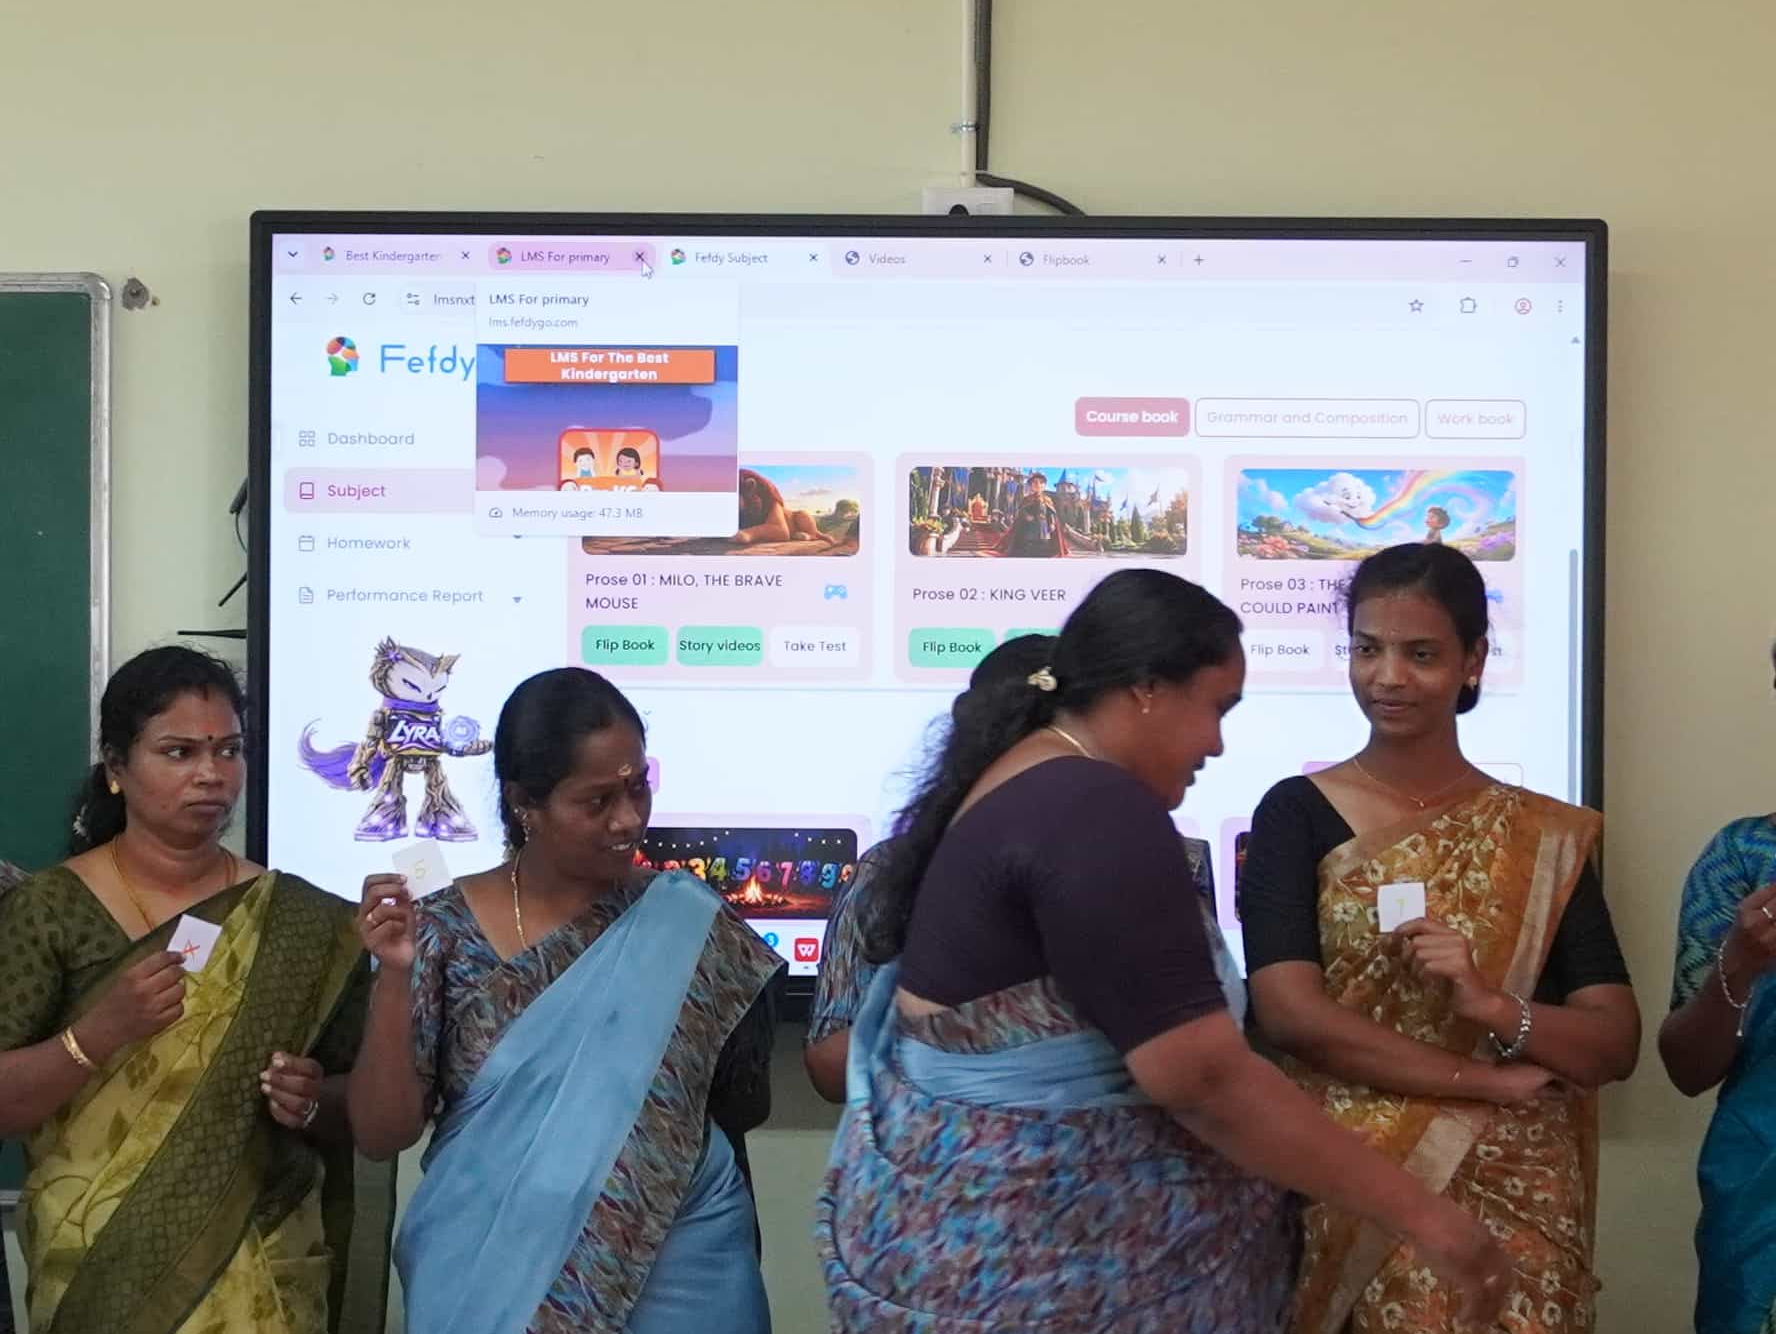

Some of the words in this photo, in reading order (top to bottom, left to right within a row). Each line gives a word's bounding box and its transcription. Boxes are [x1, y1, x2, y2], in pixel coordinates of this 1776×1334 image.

[345, 251, 370, 262] Best
[520, 251, 545, 262] LMS
[547, 252, 566, 263] For
[568, 252, 611, 266] primary
[694, 253, 724, 265] Fefdy
[727, 253, 768, 266] Subject
[868, 254, 906, 264] Videos
[489, 294, 515, 305] LMS
[518, 294, 539, 305] For
[542, 295, 590, 309] primary
[379, 344, 476, 381] Fefdy
[550, 351, 579, 364] LMS
[581, 351, 607, 364] For
[609, 351, 634, 365] The
[636, 351, 669, 365] Best
[560, 367, 658, 384] Kindergarten
[1085, 409, 1139, 425] Course
[1141, 409, 1179, 425] book
[1207, 411, 1279, 424] Grammar
[1282, 411, 1311, 424] and
[1313, 411, 1409, 428] Composition
[1437, 412, 1473, 425] Work
[1477, 412, 1514, 425] book
[327, 431, 415, 446] Dashboard
[327, 484, 386, 500] Subject
[512, 507, 558, 521] Memory
[625, 508, 644, 519] MB
[327, 536, 411, 550] Homework
[585, 573, 628, 586] Prose
[632, 573, 647, 586] 01
[659, 574, 699, 588] MILO,
[703, 574, 729, 587] THE
[734, 575, 783, 587] BRAVE
[1240, 578, 1282, 591] Prose
[1287, 578, 1306, 591] 03
[327, 588, 428, 603] Performance
[432, 589, 484, 606] Report
[912, 588, 955, 601] Prose
[959, 588, 978, 601] 02
[989, 588, 1026, 601] KING
[1030, 589, 1067, 602] VEER
[585, 597, 639, 610] MOUSE
[1240, 602, 1293, 615] COULD
[595, 639, 619, 654] Flip
[622, 639, 655, 651] Book
[679, 639, 714, 654] Story
[716, 639, 761, 652] videos
[783, 640, 815, 652] Take
[820, 641, 847, 652] Test
[923, 641, 946, 656] Flip
[950, 641, 982, 653] Book
[1250, 644, 1274, 657] Flip
[1277, 644, 1310, 656] Book
[387, 719, 441, 747] LYRA
[710, 858, 729, 881] 4
[732, 858, 751, 881] 5
[756, 861, 772, 882] 6
[777, 861, 794, 887] 7
[821, 863, 838, 888] 9
